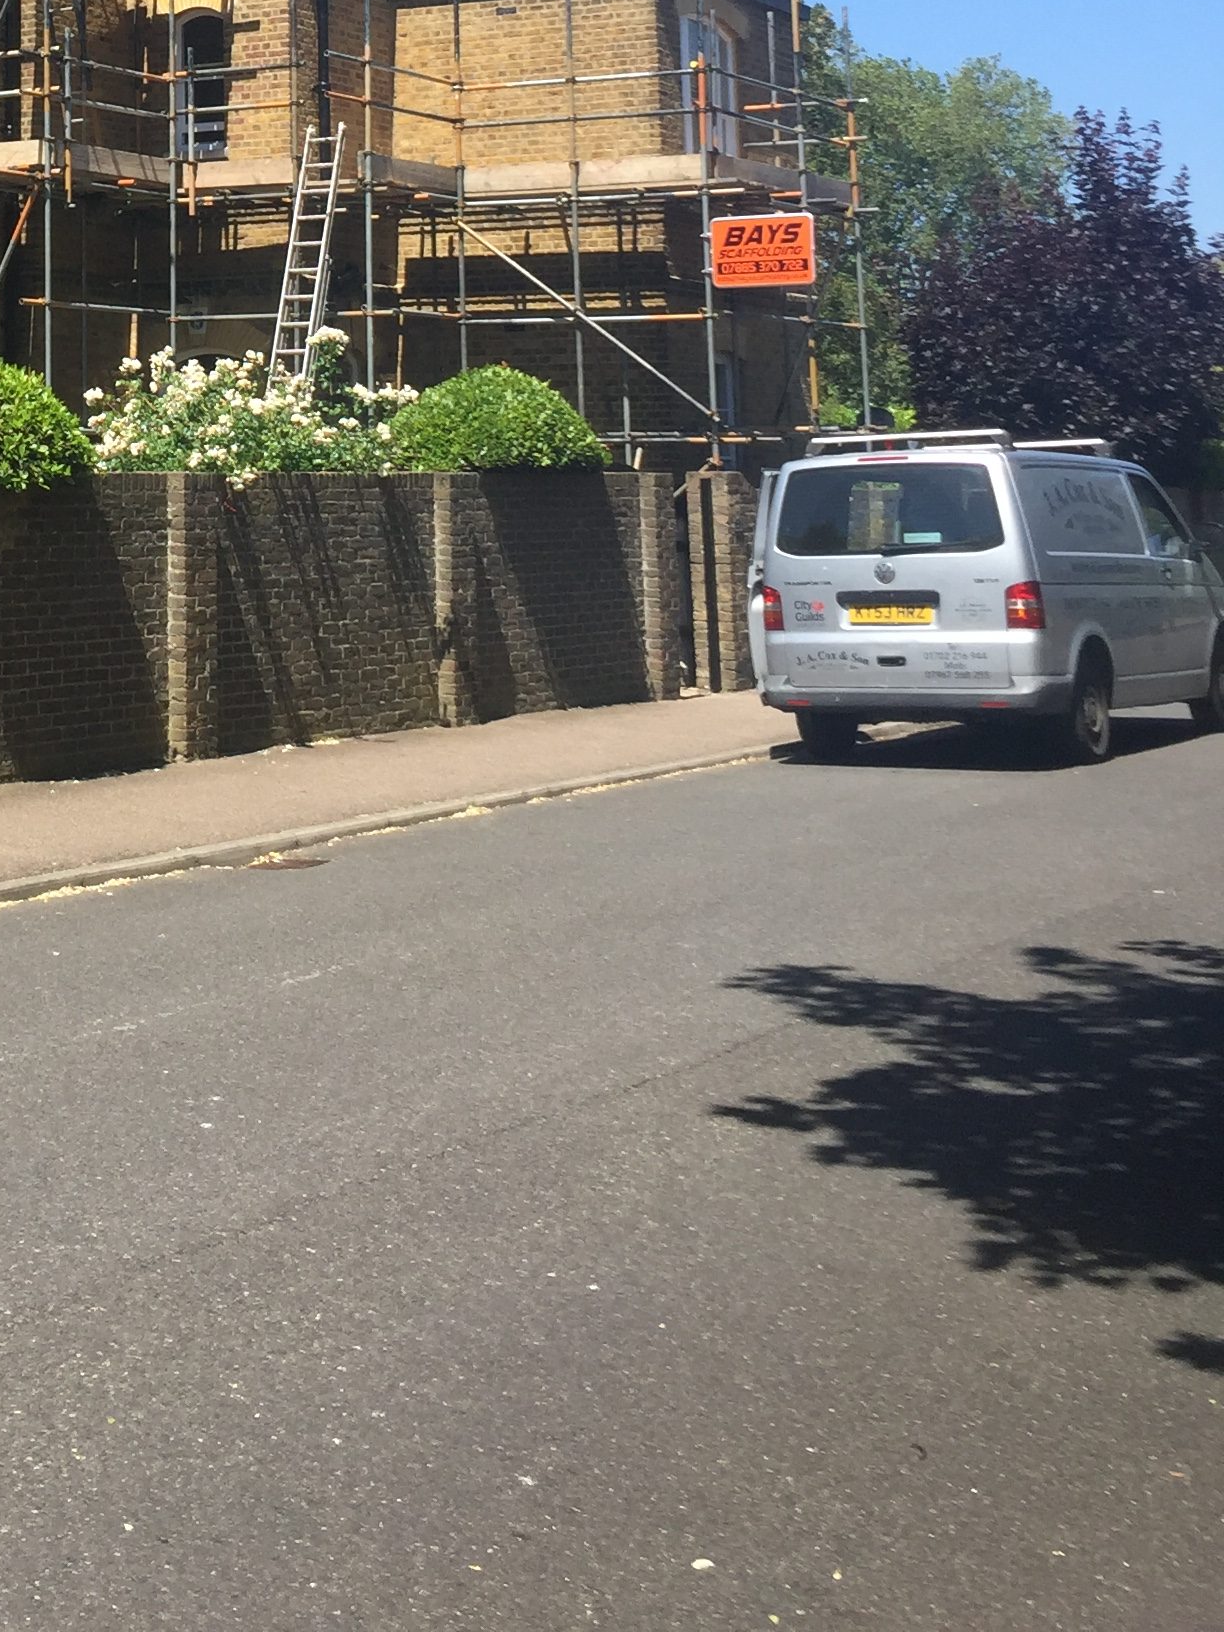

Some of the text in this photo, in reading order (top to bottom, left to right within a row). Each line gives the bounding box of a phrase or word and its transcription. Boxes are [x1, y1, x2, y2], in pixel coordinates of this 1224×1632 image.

[723, 223, 803, 247] BAYS
[718, 246, 803, 259] SCAFFOLDING
[794, 600, 812, 611] City
[795, 612, 825, 622] Guilds
